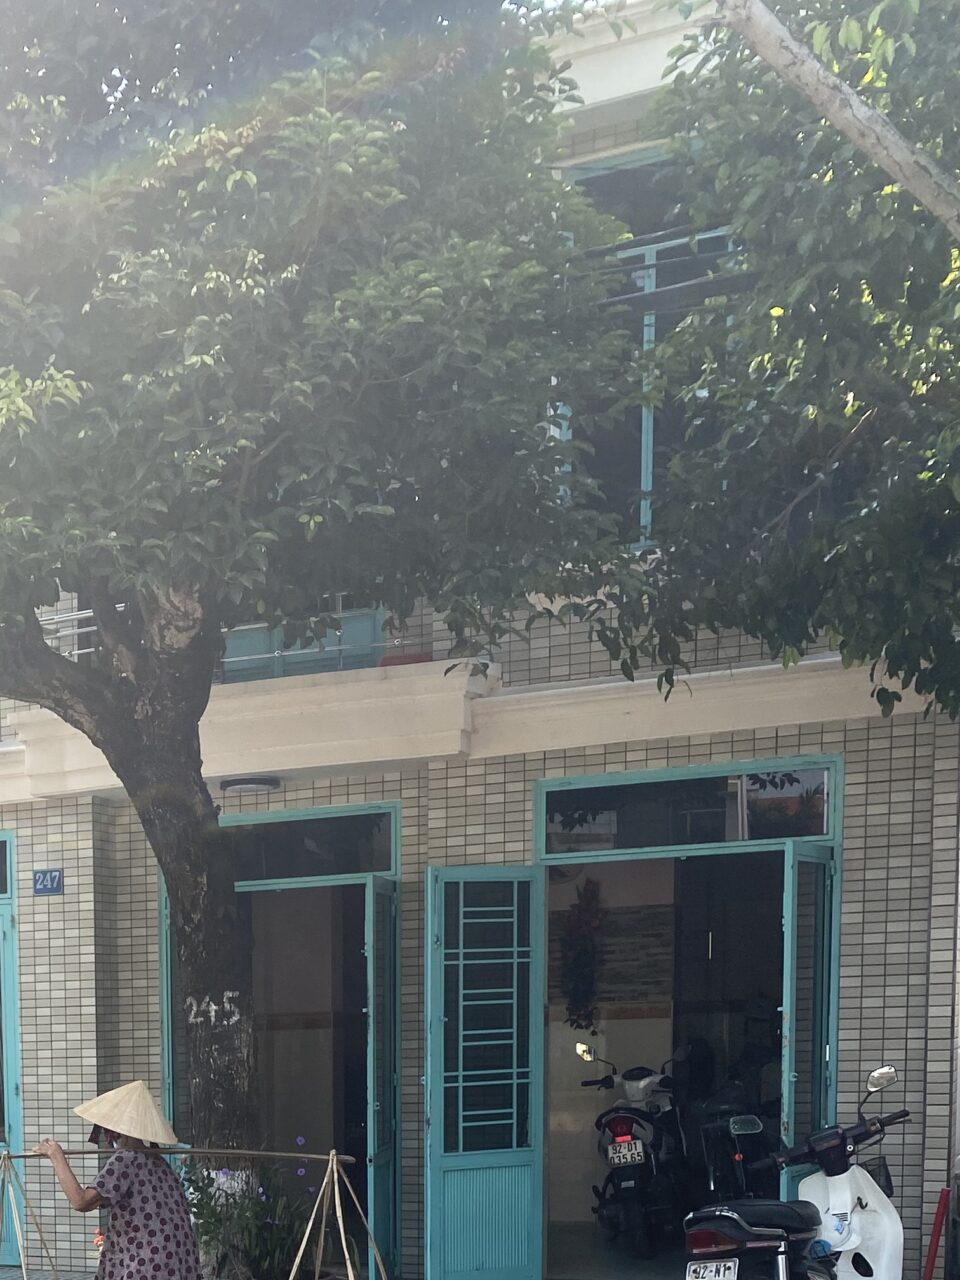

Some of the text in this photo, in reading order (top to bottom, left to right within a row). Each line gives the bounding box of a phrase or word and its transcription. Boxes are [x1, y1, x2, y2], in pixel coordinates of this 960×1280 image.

[35, 871, 60, 889] 247
[184, 990, 240, 1027] 245
[612, 1142, 638, 1154] 92-D1
[609, 1152, 642, 1166] 035.65
